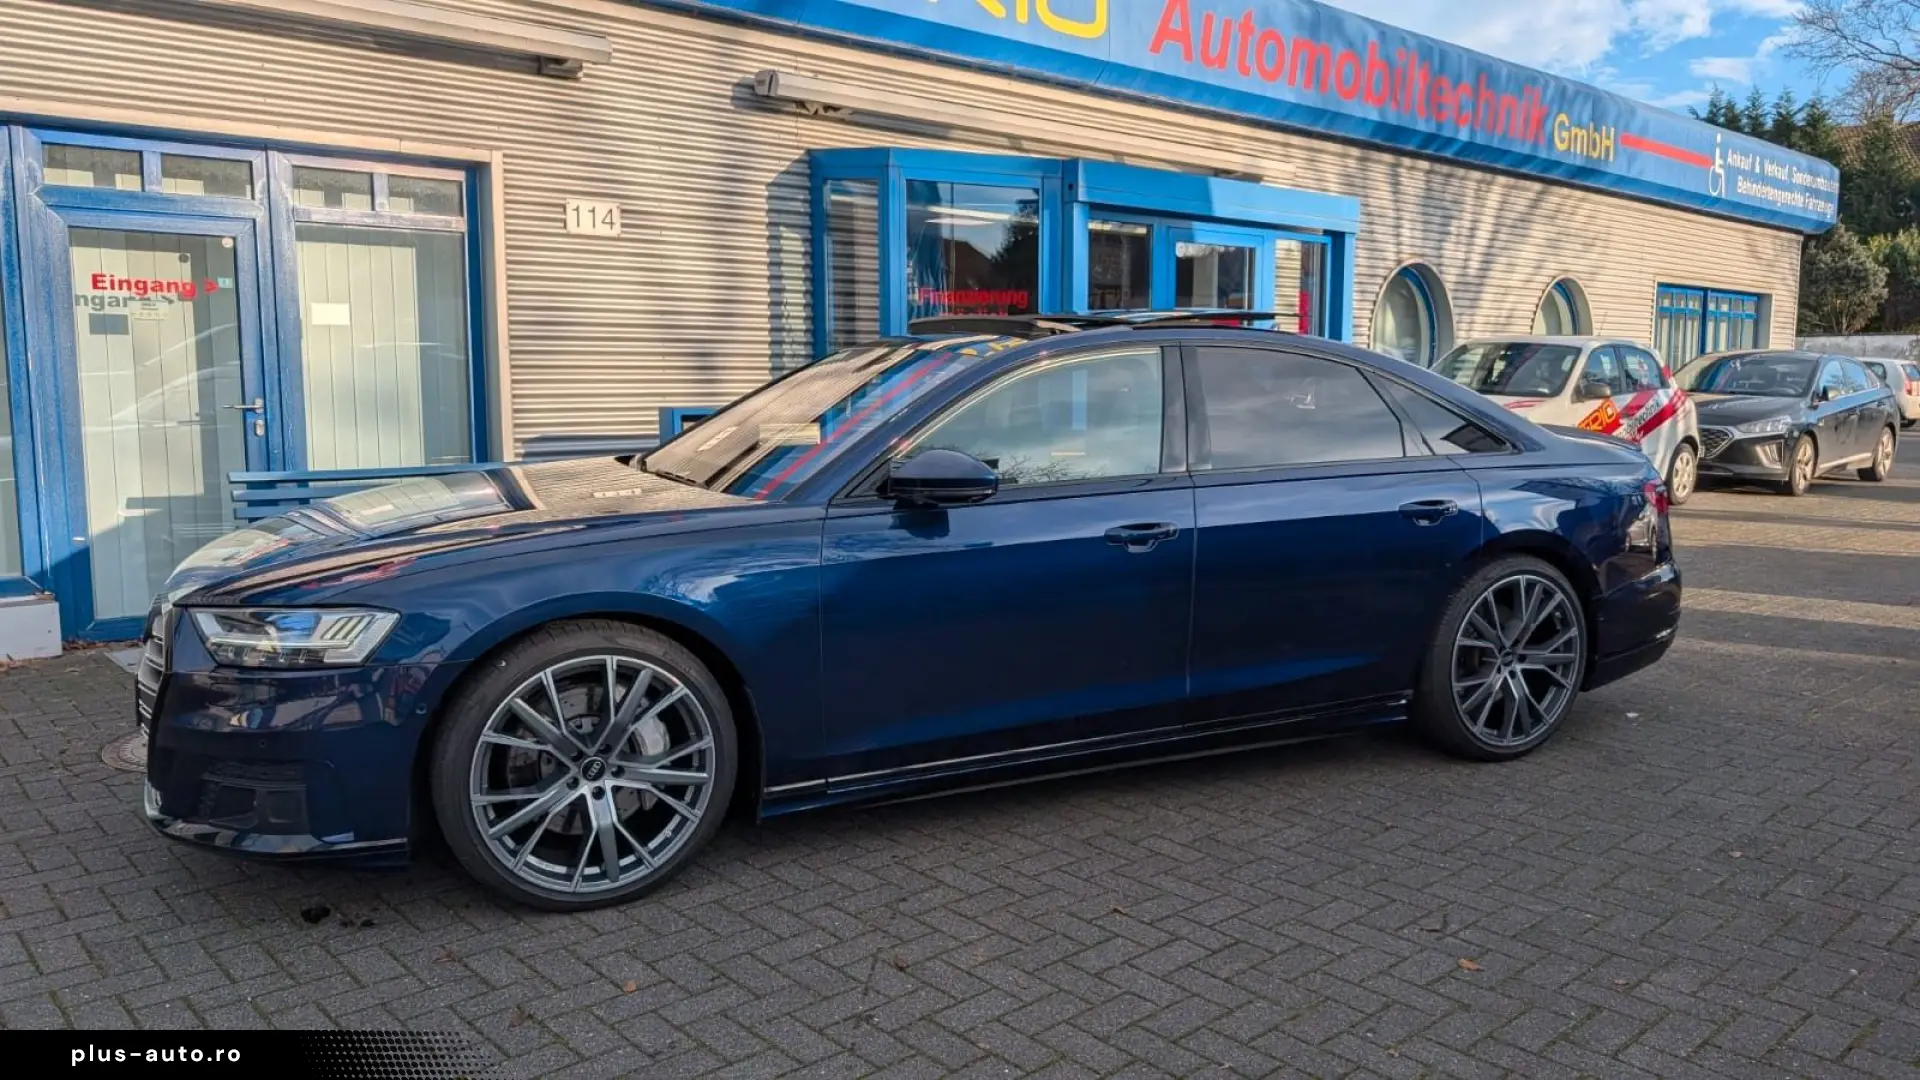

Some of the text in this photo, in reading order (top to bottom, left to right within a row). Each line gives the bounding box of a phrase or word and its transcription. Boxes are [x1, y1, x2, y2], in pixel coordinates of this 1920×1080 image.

[1149, 0, 1614, 162] Automobiltechnik GmbH
[1727, 148, 1752, 170] Ankauf
[1755, 155, 1760, 174] &
[1763, 158, 1789, 180] Verkauf
[572, 204, 616, 230] 114
[91, 273, 197, 298] Eingang
[918, 287, 1029, 309] Finanzierung
